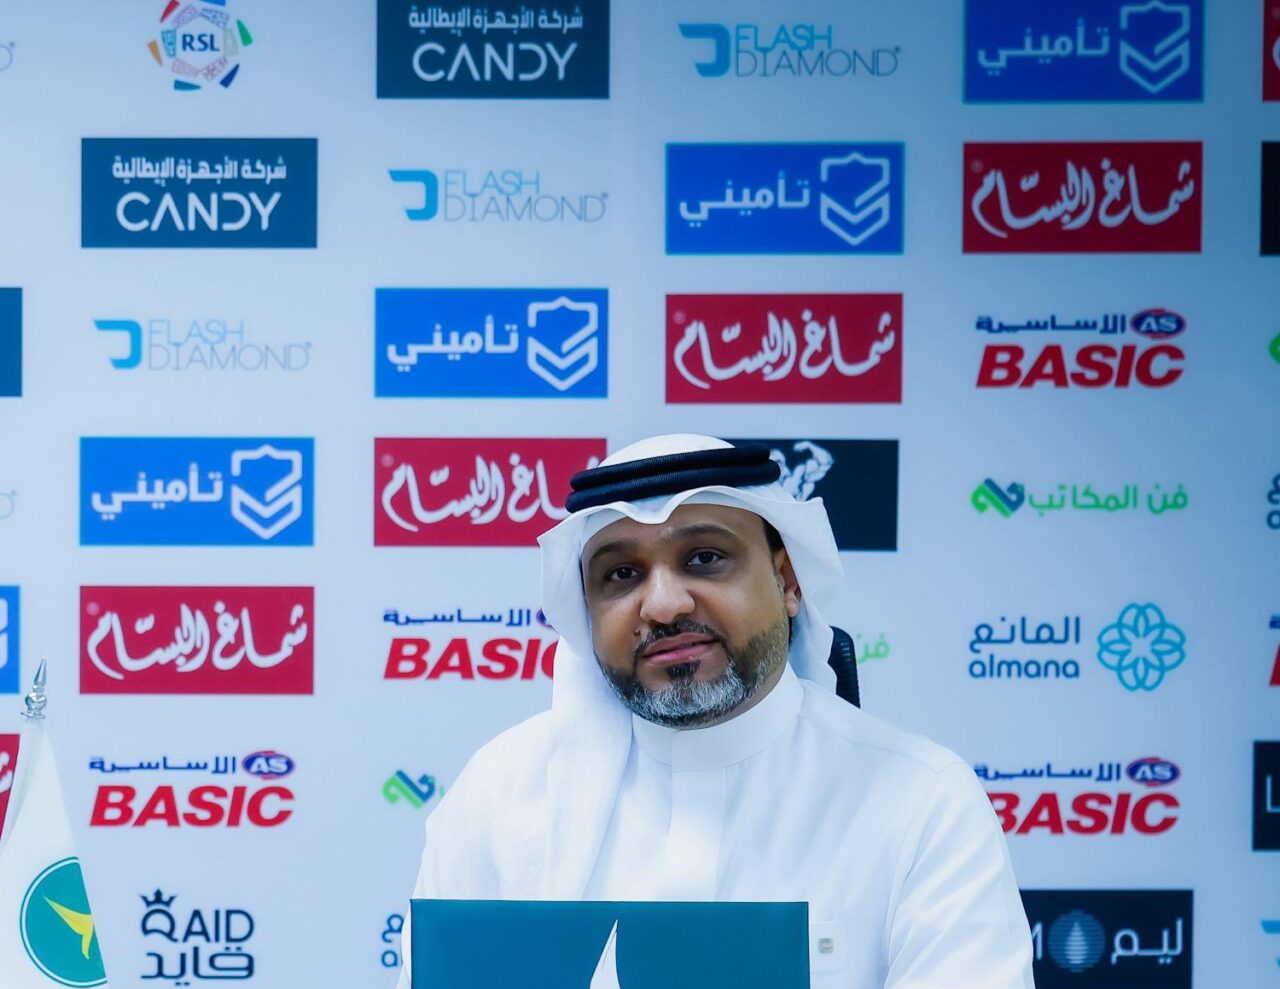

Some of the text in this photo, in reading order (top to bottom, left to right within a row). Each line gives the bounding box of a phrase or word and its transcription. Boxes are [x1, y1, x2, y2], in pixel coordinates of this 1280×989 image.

[537, 7, 584, 34] شركة
[734, 24, 833, 51] FLASH
[181, 32, 220, 52] RSL
[411, 41, 578, 82] CANDY
[976, 22, 1111, 76] تأميني
[734, 47, 899, 78] DIAMOND
[240, 156, 287, 185] شركة
[444, 169, 539, 196] FLASH
[115, 191, 282, 232] CANDY
[444, 193, 606, 223] DIAMOND
[678, 171, 811, 229] تأميني
[1098, 157, 1195, 228] شماغ
[148, 319, 243, 346] FLASH
[386, 314, 520, 373] تأميني
[799, 309, 896, 380] شماغ
[148, 342, 309, 371] DIAMOND
[975, 342, 1186, 389] BASIC
[90, 462, 224, 521] تأميني
[1146, 483, 1190, 516] فن
[216, 600, 308, 671] شماغ
[968, 615, 1081, 655] المانع
[968, 656, 1081, 680] almana
[89, 784, 295, 829] BASIC
[140, 906, 257, 945] QAID
[1110, 917, 1184, 965] ليم
